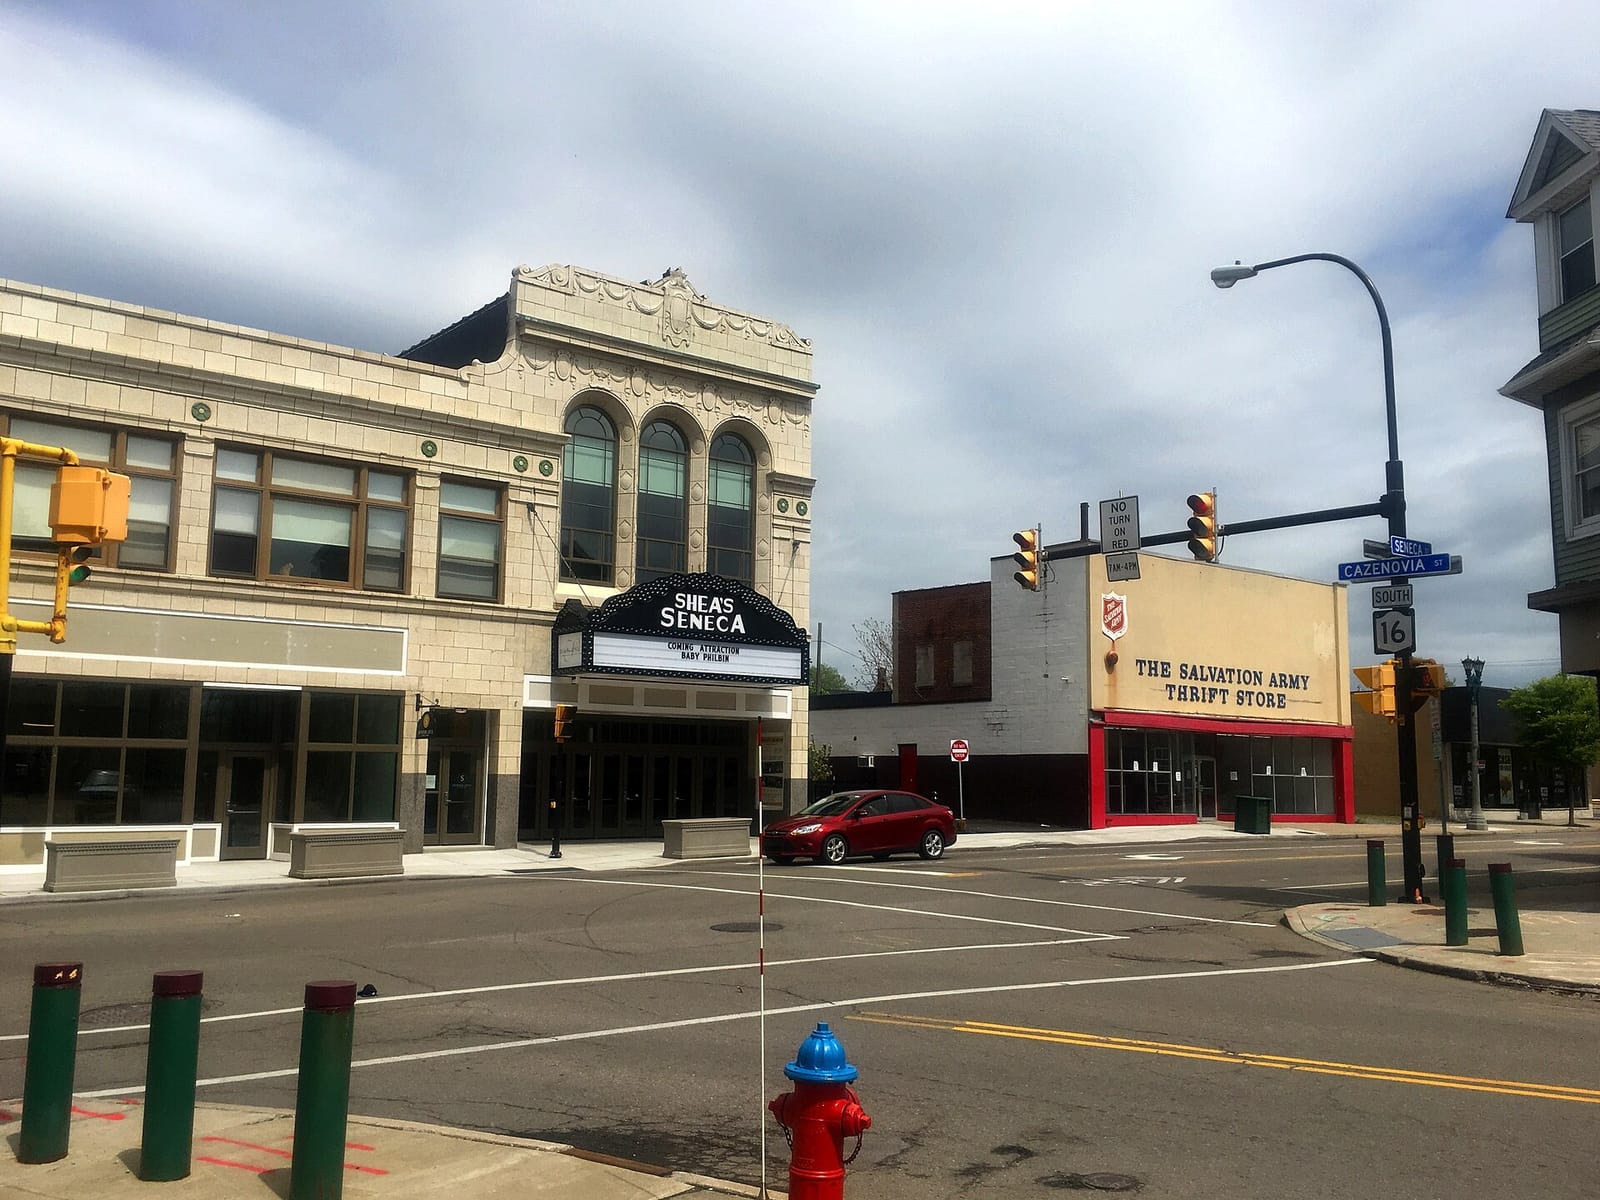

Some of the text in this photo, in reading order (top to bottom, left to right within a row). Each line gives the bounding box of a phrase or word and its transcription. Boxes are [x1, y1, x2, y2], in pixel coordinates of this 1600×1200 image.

[1111, 501, 1127, 513] NO
[1109, 514, 1131, 525] TURN
[1114, 527, 1126, 536] ON
[1112, 539, 1129, 549] RED
[1394, 539, 1423, 555] SENECA
[1344, 558, 1443, 577] CAZENOVIA ST
[674, 592, 734, 614] SHEA'S
[1375, 590, 1410, 603] SOUTH
[660, 607, 746, 634] SENECA
[1380, 620, 1406, 644] 16
[667, 642, 740, 655] COMING ATTRACTION
[681, 652, 730, 662] BABY PHILBIN
[1136, 659, 1310, 690] THE SALVATION ARMY
[1166, 684, 1286, 708] THRIFT STORE
